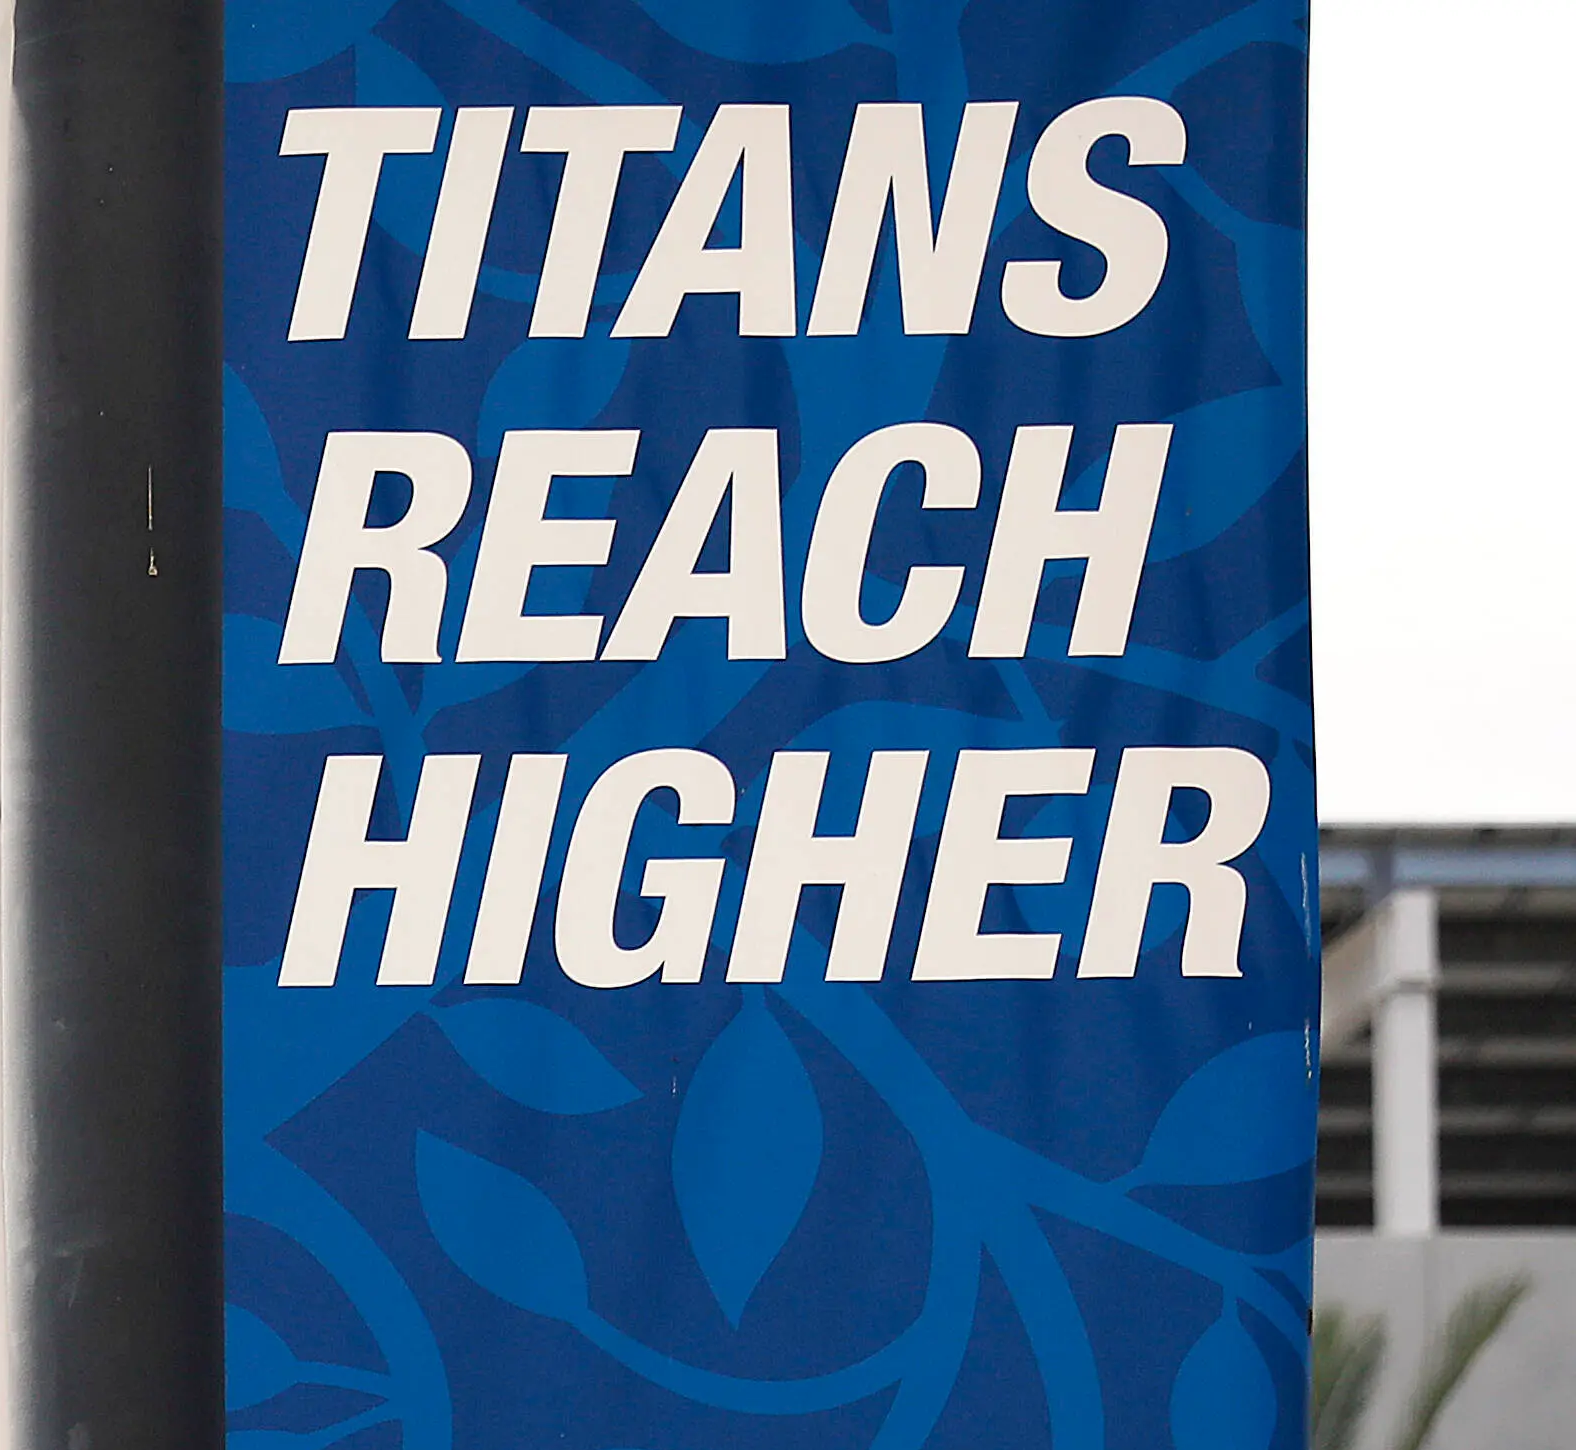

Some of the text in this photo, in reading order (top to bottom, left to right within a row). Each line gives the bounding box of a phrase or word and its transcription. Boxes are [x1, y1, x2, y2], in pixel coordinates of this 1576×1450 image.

[278, 95, 1188, 342] TITANS
[278, 422, 1173, 664] REACH
[278, 746, 1271, 989] HIGHER
